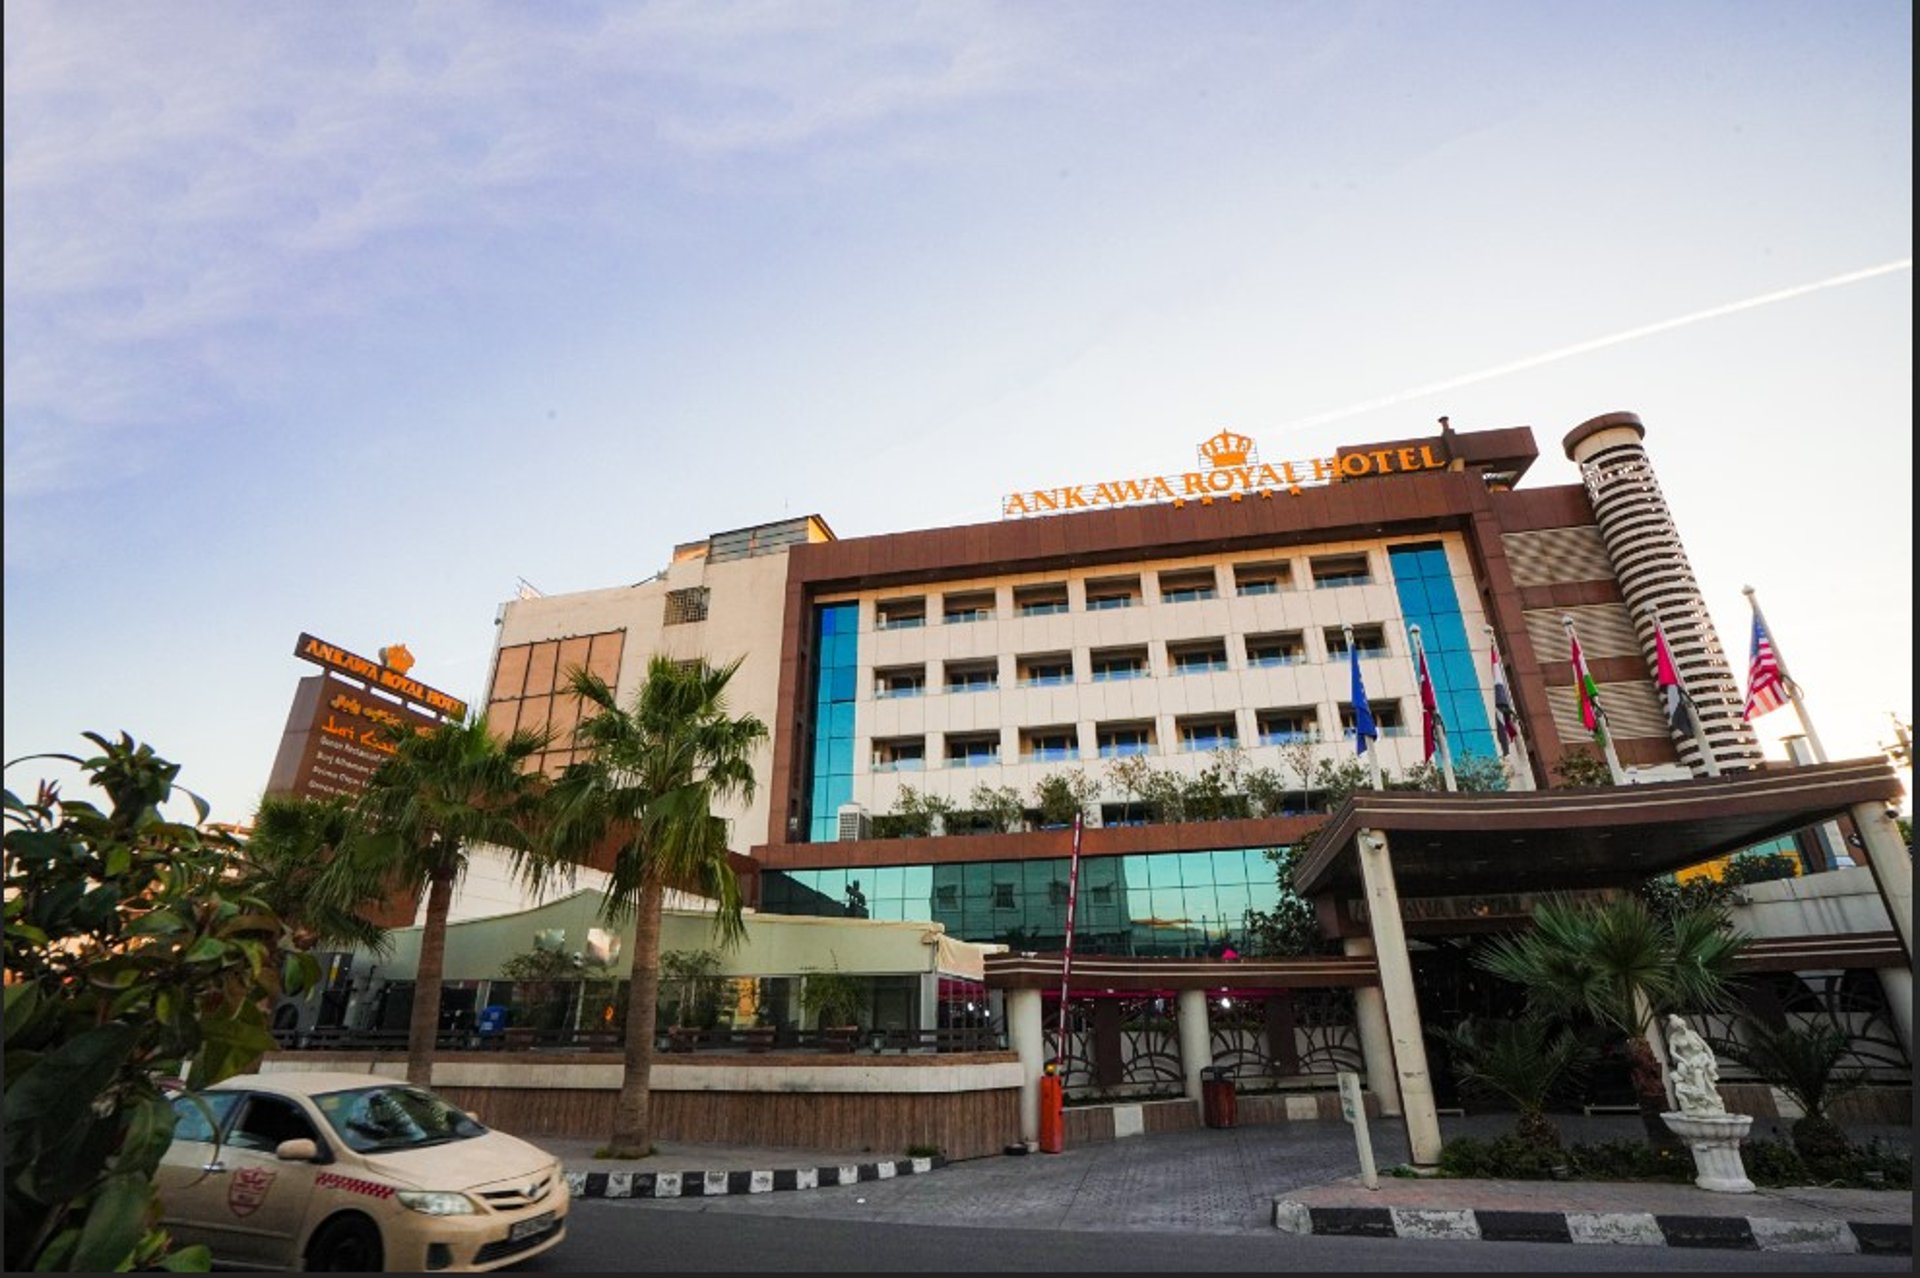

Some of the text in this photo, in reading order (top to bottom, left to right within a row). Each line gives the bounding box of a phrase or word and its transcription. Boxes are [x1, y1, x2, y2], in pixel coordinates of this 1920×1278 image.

[1006, 445, 1446, 515] ANKAWA ROYAL HOTEL
[306, 639, 379, 681] ANKAWA
[381, 671, 426, 700] ROYAL
